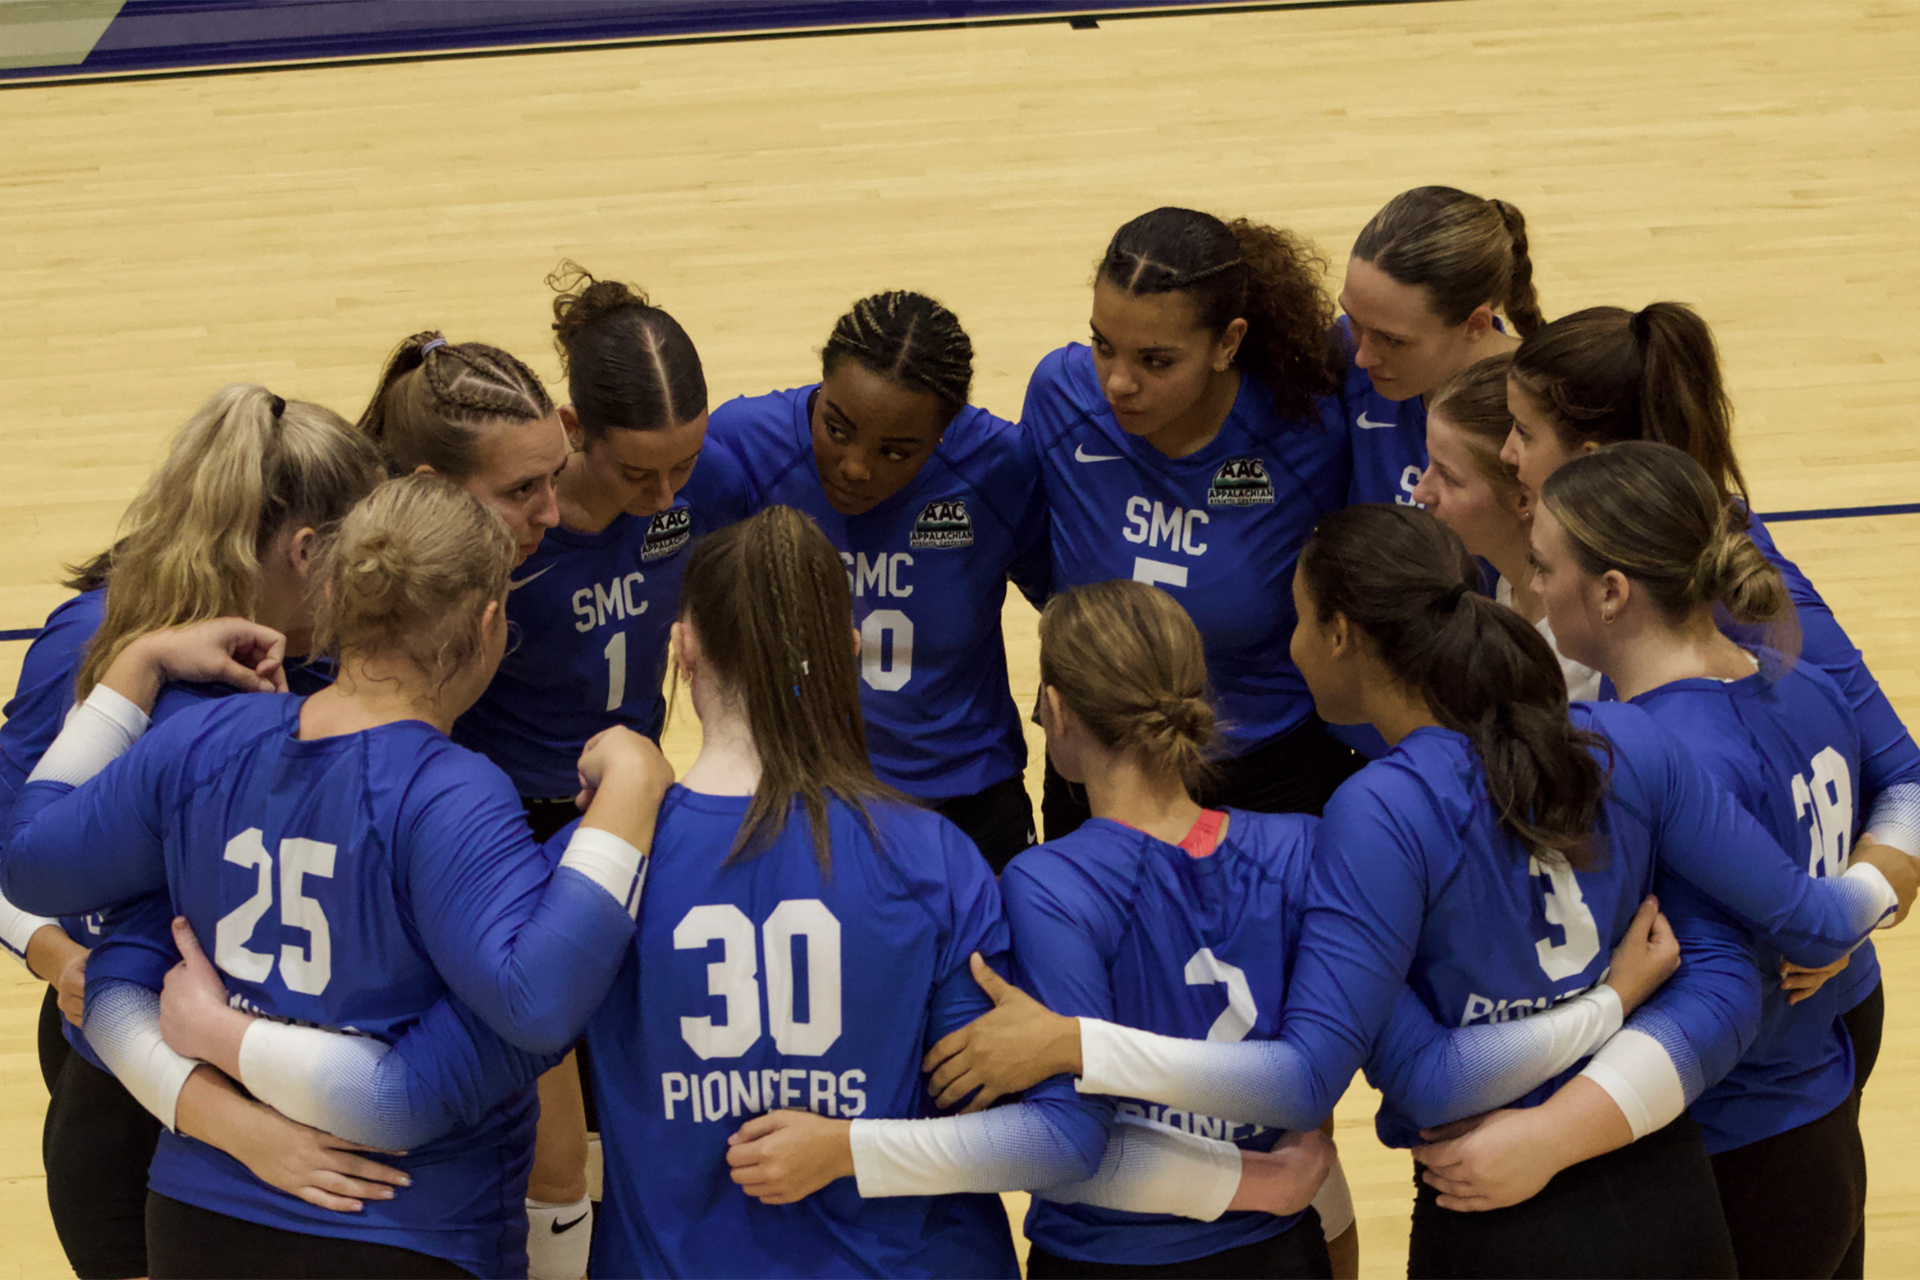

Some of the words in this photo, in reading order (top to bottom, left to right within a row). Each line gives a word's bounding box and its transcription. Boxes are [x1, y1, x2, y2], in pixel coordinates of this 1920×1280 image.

[1209, 489, 1273, 498] APPALACHIAN
[1221, 459, 1263, 478] AAC
[651, 508, 688, 533] AAC
[911, 530, 973, 540] APPALACHIAN
[922, 502, 965, 521] AAC
[1122, 495, 1209, 556] SMC
[572, 572, 648, 633] SMC
[604, 631, 626, 711] 1
[861, 609, 914, 692] 0
[1791, 746, 1853, 878] 28
[214, 826, 337, 996] 25
[1529, 849, 1600, 982] 3
[673, 899, 842, 1060] 30
